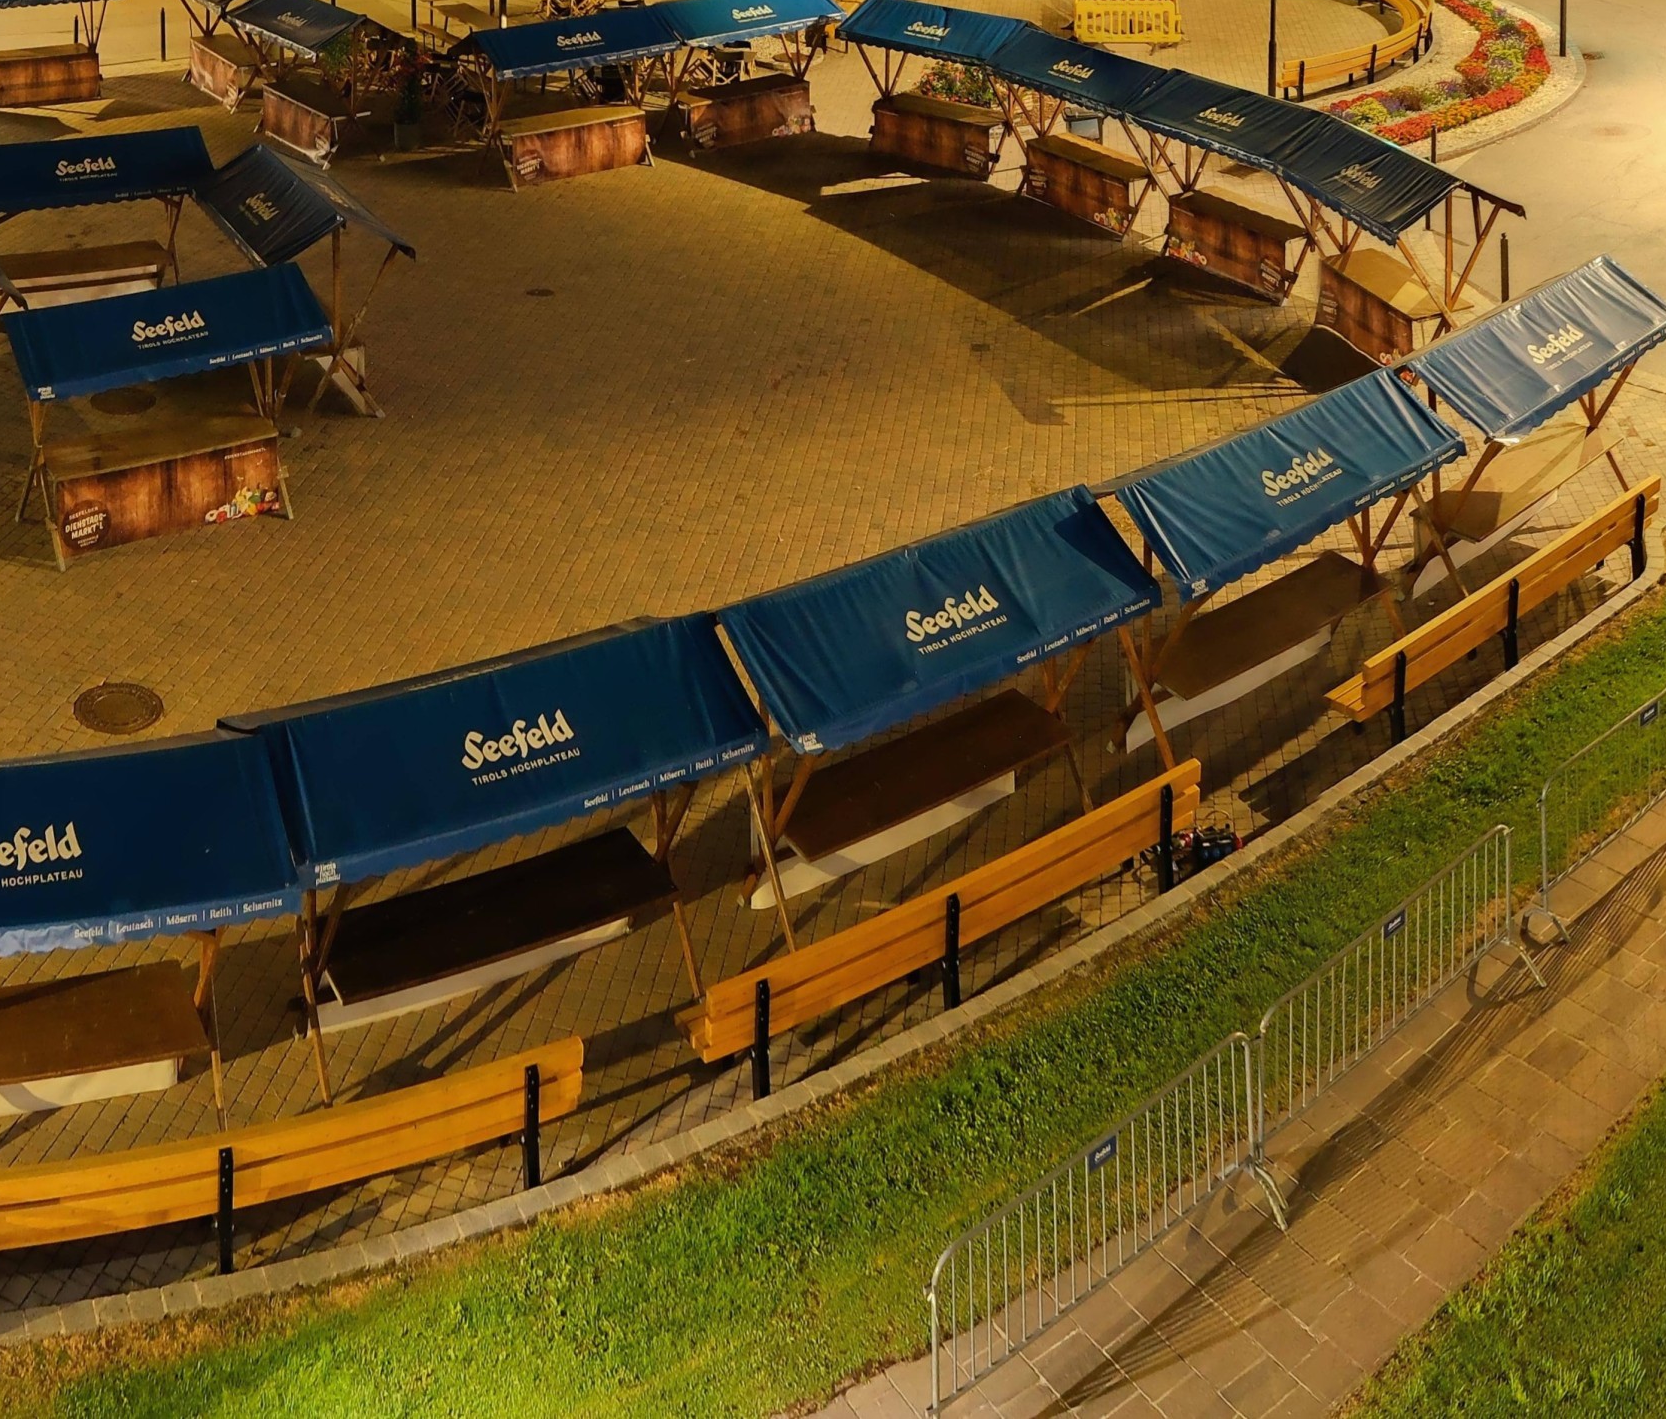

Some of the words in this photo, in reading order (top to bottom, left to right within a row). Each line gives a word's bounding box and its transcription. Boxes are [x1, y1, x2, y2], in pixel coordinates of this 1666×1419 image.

[732, 4, 774, 20] Seefeld
[556, 31, 602, 48] Seefeld
[907, 21, 951, 38] Seefeld
[1052, 59, 1096, 79] Seefeld
[1197, 106, 1246, 128] Seefeld
[54, 156, 117, 177] Seefeld
[244, 191, 282, 222] Seefeld
[131, 309, 206, 342] Seefeld
[137, 340, 161, 350] TIROLS
[162, 331, 209, 346] HOCHPLATEAU
[1527, 322, 1585, 365] Seefeld
[1261, 446, 1335, 498] Seefeld
[1276, 491, 1302, 507] TIROLS
[65, 512, 107, 533] DIENSTAGS-
[68, 506, 99, 521] SEEFELDER
[71, 523, 104, 541] MARKT'L
[905, 583, 1000, 644] Seefeld
[917, 638, 948, 657] TIROLS
[949, 614, 1008, 644] HOCHPLATEAU
[1015, 649, 1037, 665] Seefeld
[1043, 634, 1069, 653] Leutasch
[1075, 623, 1097, 638] Mösern
[1103, 612, 1119, 625] Reith
[1123, 597, 1151, 615] Scharnitz
[461, 707, 575, 771] Seefeld
[471, 769, 509, 787] TIROLS
[510, 747, 582, 778] HOCHPLATEAU
[583, 792, 609, 809] Seefeld
[618, 778, 651, 798] Leutasch
[659, 766, 687, 784] Mösern
[694, 756, 715, 772] Reith
[721, 742, 755, 762] Scharnitz
[0, 868, 84, 888] HOCHPLATEAU
[73, 924, 104, 940] Seefeld
[115, 917, 155, 934] Leutasch
[166, 910, 199, 926] Mösern
[209, 905, 233, 919] Reith
[242, 897, 284, 914] Scharnitz
